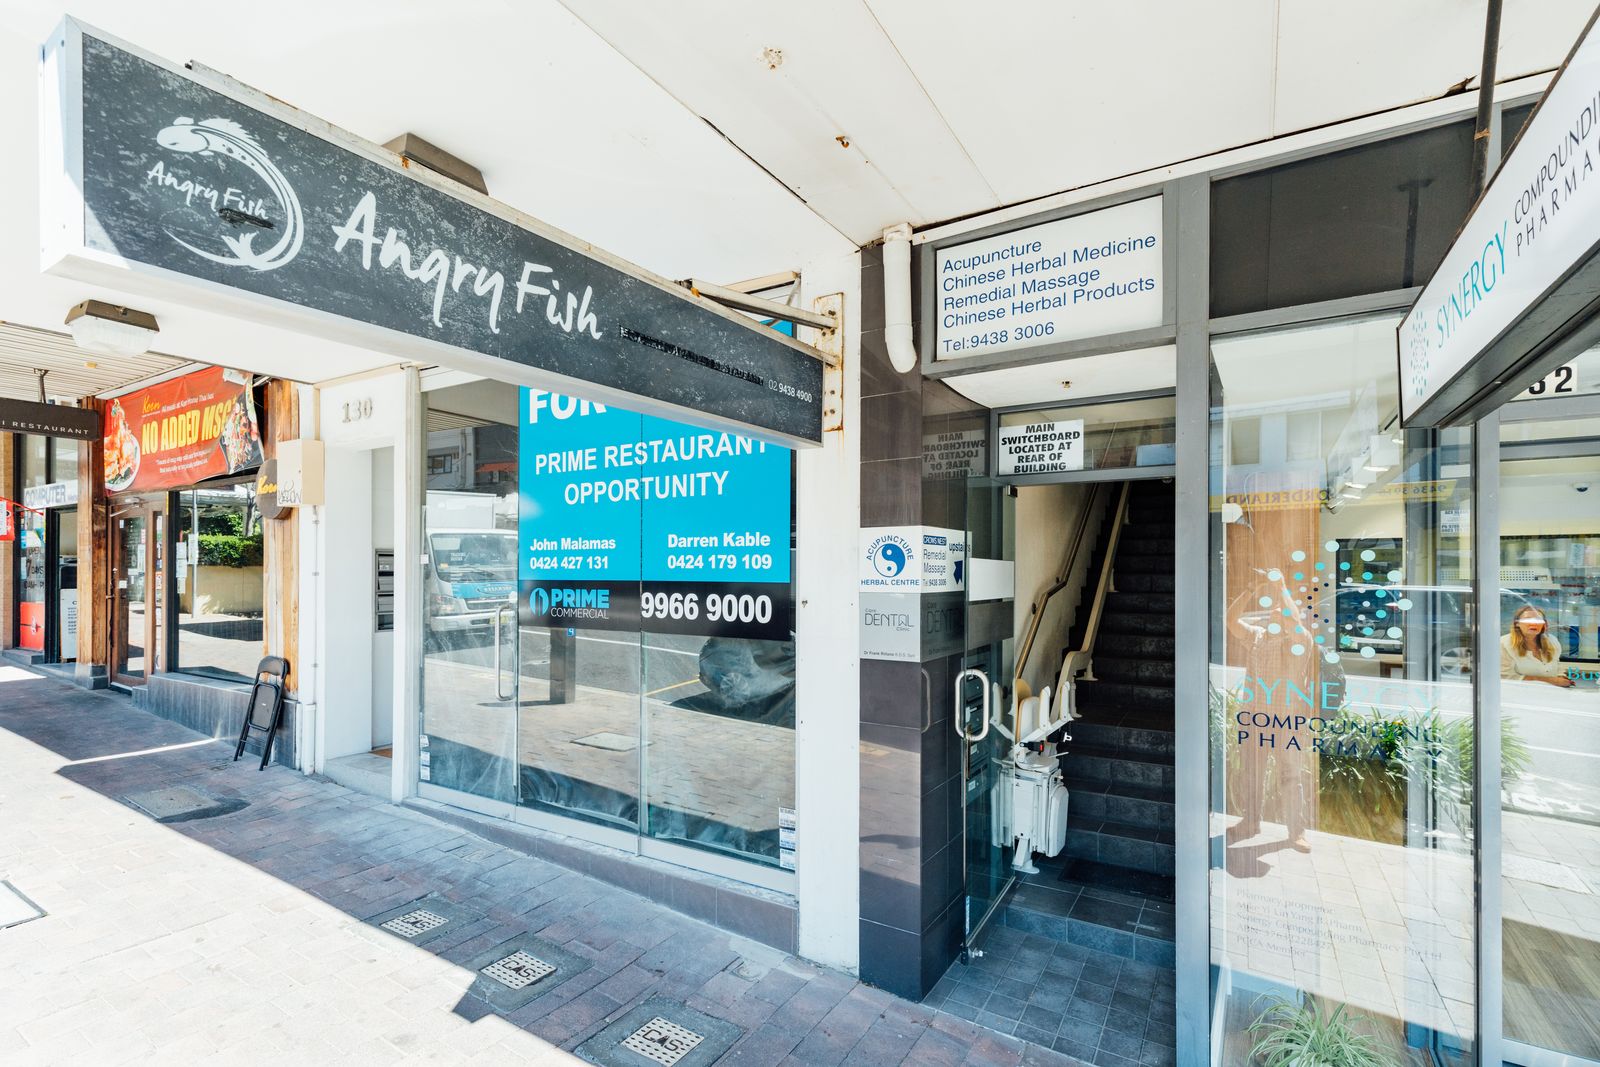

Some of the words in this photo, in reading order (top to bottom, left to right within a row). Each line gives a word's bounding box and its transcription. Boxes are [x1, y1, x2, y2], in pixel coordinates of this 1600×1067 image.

[1514, 91, 1600, 225] COMPOUNDI
[147, 160, 219, 212] Angry
[223, 187, 269, 220] Fish
[1516, 135, 1600, 257] PHARMA
[331, 191, 504, 334] Angry
[516, 261, 602, 340] Fish
[943, 241, 1042, 274] Acupuncture
[943, 269, 1005, 292] Chinese
[1011, 252, 1066, 277] Herbal
[1073, 235, 1156, 263] Medicine
[944, 284, 1016, 311] Remedial
[1022, 269, 1100, 295] Massage
[1437, 221, 1507, 349] SYNERGY
[943, 307, 1006, 329] Chinese
[1012, 293, 1066, 316] Herbal
[1073, 278, 1155, 304] Products
[943, 330, 1008, 353] Tel:9438
[1014, 321, 1055, 341] 3006
[768, 379, 778, 391] 02
[779, 383, 796, 397] 9438
[796, 390, 812, 403] 4900
[12, 421, 89, 435] RESTAURANT
[142, 420, 159, 456] NO
[160, 409, 201, 451] ADDED
[1001, 431, 1081, 446] SWITCHBOARD
[1025, 423, 1055, 434] MAIN
[1008, 443, 1054, 455] LOCATED
[1058, 441, 1073, 451] AT
[1017, 453, 1045, 464] REAR
[1049, 452, 1063, 461] OF
[535, 448, 597, 475] PRIME
[1014, 462, 1066, 473] BUILDING
[564, 471, 729, 505] OPPORTUNITY
[530, 538, 558, 551] John
[561, 537, 616, 550] Malamas
[667, 534, 719, 548] Darren
[723, 532, 771, 547] Kable
[866, 535, 914, 561] ACUPUNCTURE
[530, 557, 560, 569] 0424
[561, 557, 583, 569] 427
[586, 556, 609, 569] 131
[667, 555, 704, 569] 0424
[708, 555, 737, 569] 179
[742, 554, 772, 569] 109
[923, 549, 946, 561] Remedial
[923, 562, 946, 575] Massage
[550, 589, 610, 609] PRIME
[641, 592, 699, 621] 9966
[706, 594, 772, 624] 9000
[550, 607, 610, 619] COMMERCIAL
[865, 612, 914, 627] DENTAL
[1234, 671, 1440, 719] SYNERGY
